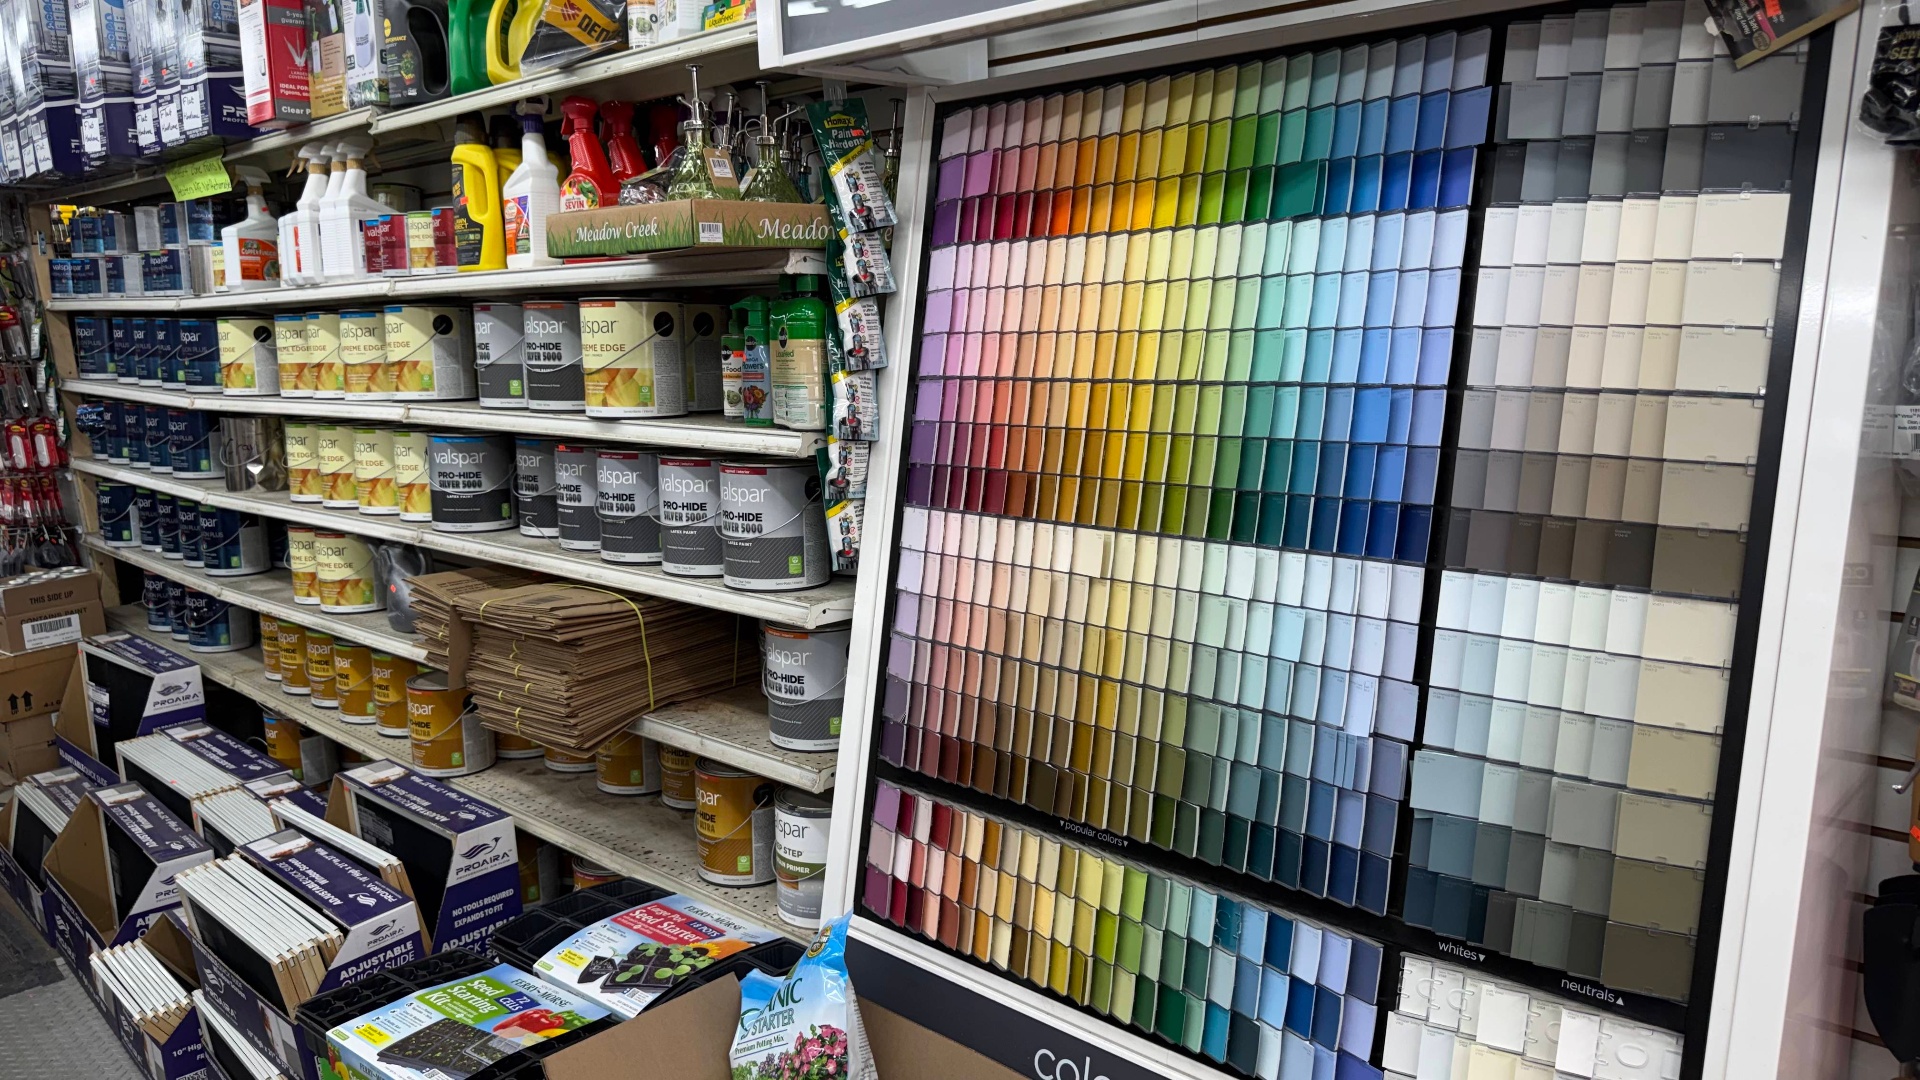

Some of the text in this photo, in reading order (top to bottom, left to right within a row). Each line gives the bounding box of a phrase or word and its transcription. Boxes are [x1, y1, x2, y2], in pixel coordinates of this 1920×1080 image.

[280, 83, 298, 91] IDEAL
[281, 105, 305, 115] Clear
[565, 200, 584, 210] SEVIN
[409, 216, 433, 231] alspar
[576, 217, 658, 243] Meadow Creek
[77, 328, 96, 338] spar
[276, 325, 305, 342] alspar
[386, 320, 404, 335] spar
[525, 316, 563, 338] alspar
[581, 318, 617, 338] alspar
[181, 329, 202, 342] lspar
[583, 343, 626, 352] REME EDGE
[543, 352, 562, 361] 5000
[169, 421, 188, 432] spar
[288, 435, 308, 448] spar
[319, 437, 339, 450] spar
[356, 441, 378, 454] spar
[434, 449, 485, 467] valspar
[516, 454, 541, 468] spar
[438, 471, 482, 480] PRO-HIDE
[517, 474, 539, 483] O-HIDE
[598, 465, 638, 488] alspar
[439, 479, 483, 489] SILVER 5000
[556, 484, 582, 493] O-HIDE
[565, 493, 582, 503] 5000
[722, 481, 764, 507] alspar
[615, 502, 636, 513] 5000
[663, 500, 708, 512] PRO-HIDE
[201, 516, 218, 528] spar
[663, 511, 708, 523] SILVER 5000
[741, 522, 763, 534] 5000
[29, 590, 74, 605] THIS SIDE UP
[186, 595, 207, 608] spar
[65, 607, 88, 616] PAINT
[335, 656, 352, 668] spar
[767, 643, 808, 669] alspar
[374, 666, 392, 680] spar
[784, 683, 805, 696] 5000
[153, 693, 199, 708] PROAIRA
[408, 698, 434, 716] lspar
[410, 718, 431, 730] O-HIDE
[663, 746, 690, 758] O-HIDE
[695, 787, 720, 807] spar
[697, 810, 716, 824] -HIDE
[776, 811, 808, 839] lspar
[1065, 821, 1122, 847] popular colors
[783, 845, 803, 858] STEP
[455, 851, 510, 876] PROAIRA
[786, 862, 811, 874] PRIMER
[452, 888, 514, 918] NO TOOLS REQUIRED
[454, 903, 504, 929] EXPANDS TO FIT
[647, 904, 686, 923] Large Pot
[630, 909, 703, 942] Seed Starter
[689, 920, 721, 938] 18 POTS
[367, 927, 404, 947] PROAIRA
[441, 915, 516, 954] ADJUSTAB
[1438, 941, 1478, 962] whites
[340, 940, 414, 981] ADJUSTABLE
[384, 950, 415, 969] SLIDE
[467, 978, 504, 998] Seed
[763, 977, 803, 1012] ANIC
[1561, 977, 1615, 1003] neutrals
[425, 990, 452, 1008] Kit
[447, 985, 499, 1014] Starting
[499, 996, 525, 1012] CELLS
[518, 995, 531, 1004] 72
[750, 1008, 796, 1037] STARTER
[173, 1042, 202, 1057] 10" Hig
[734, 1034, 785, 1056] Premium Potting Mix
[1034, 1048, 1111, 1080] col
